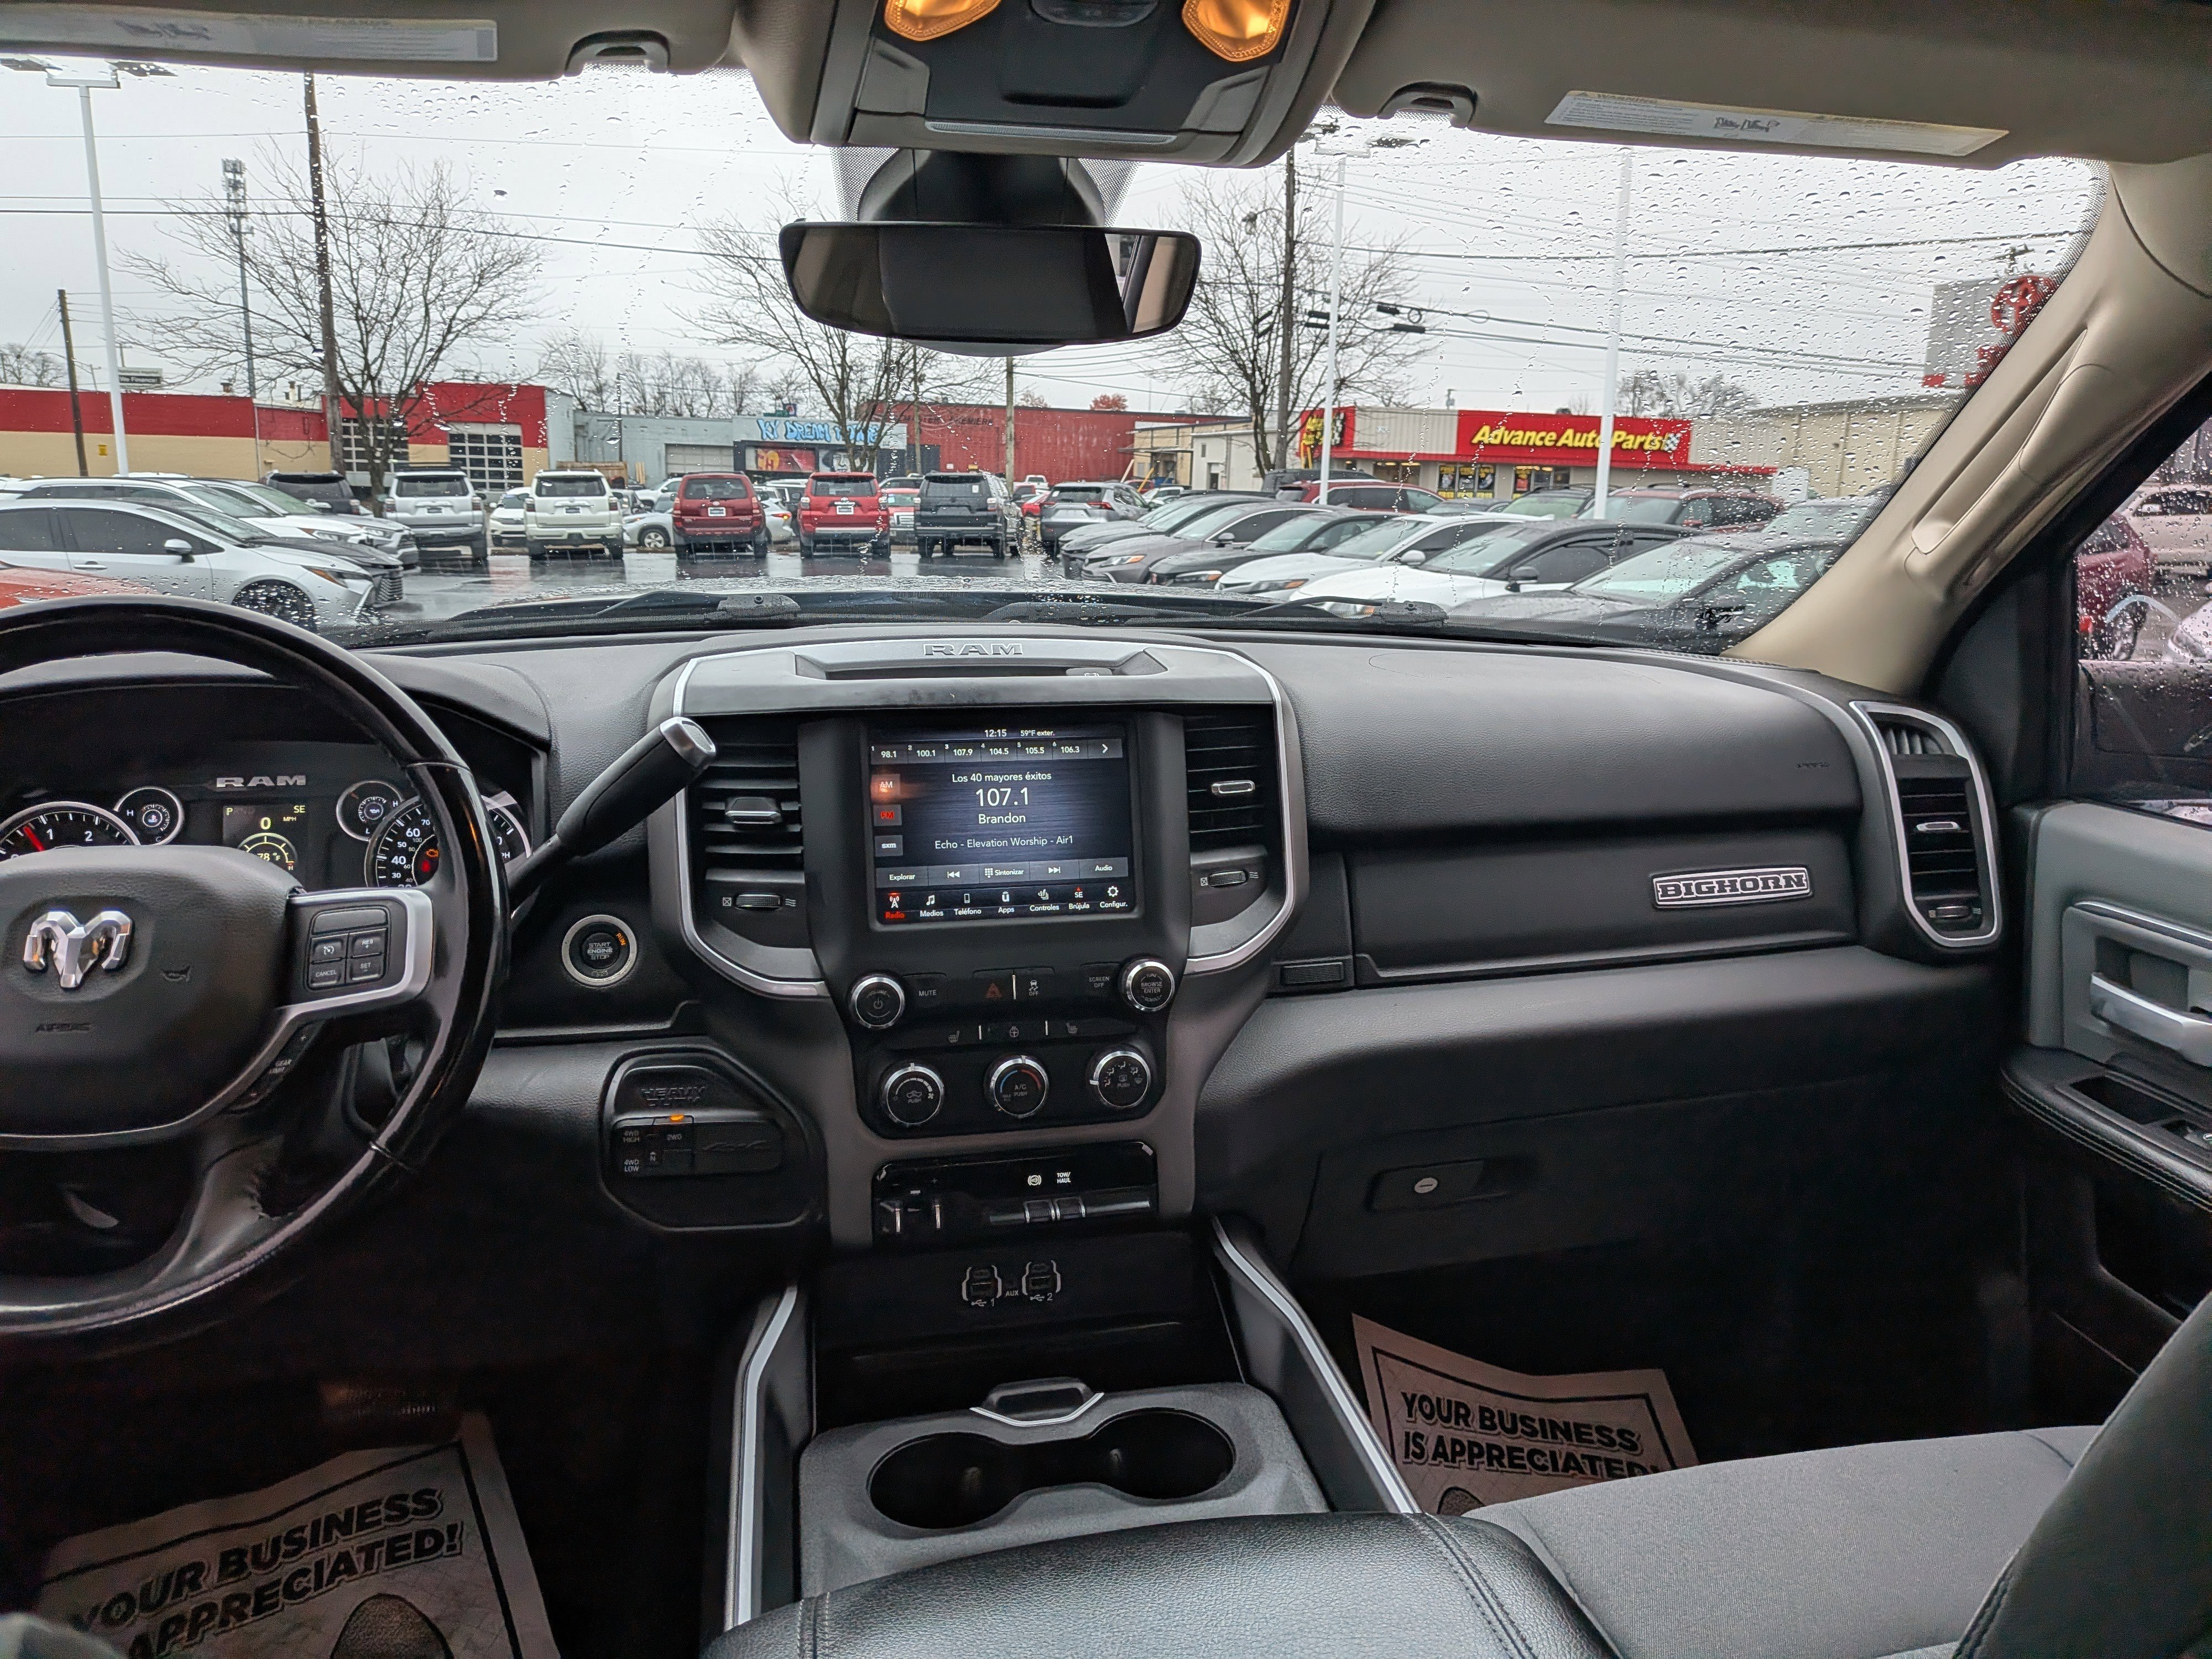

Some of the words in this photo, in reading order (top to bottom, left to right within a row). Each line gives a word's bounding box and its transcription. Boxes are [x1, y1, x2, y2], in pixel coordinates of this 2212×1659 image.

[757, 419, 779, 440] KY
[785, 420, 831, 442] DREAM
[1472, 425, 1556, 447] Advance
[1556, 428, 1601, 448] Auto
[1610, 430, 1663, 451] Parts
[923, 644, 1022, 656] RAM
[984, 729, 1007, 738] 12:15
[216, 775, 306, 787] RAM
[952, 774, 968, 782] Los
[971, 773, 982, 782] 40
[984, 774, 1023, 782] mayores
[1025, 771, 1052, 781] éxitos
[975, 787, 1029, 807] 107.1
[226, 807, 233, 816] P
[293, 805, 306, 813] SE
[260, 817, 272, 830] 0
[978, 812, 1026, 824] Brandon
[46, 828, 54, 840] 1
[85, 831, 93, 842] 2
[405, 828, 421, 838] 60
[935, 839, 958, 849] Echo
[967, 837, 1008, 848] Elevation
[1010, 836, 1047, 848] Worship
[1056, 835, 1073, 845] Air1
[391, 855, 406, 865] 40
[1657, 873, 1807, 900] BIGHORN
[998, 906, 1015, 914] Apps
[1068, 902, 1090, 910] Brújula
[1099, 900, 1128, 909] Configur.
[919, 909, 944, 917] Medios
[953, 907, 982, 916] Teléfono
[616, 932, 627, 946] RUN
[1047, 1293, 1053, 1301] 2
[1401, 1392, 1471, 1428] YOUR
[1479, 1406, 1641, 1452] BUSINESS
[1404, 1431, 1427, 1460] IS
[71, 1559, 209, 1632] YOUR
[216, 1488, 442, 1583] BUSINESS
[128, 1522, 465, 1659] APPRECIATED!
